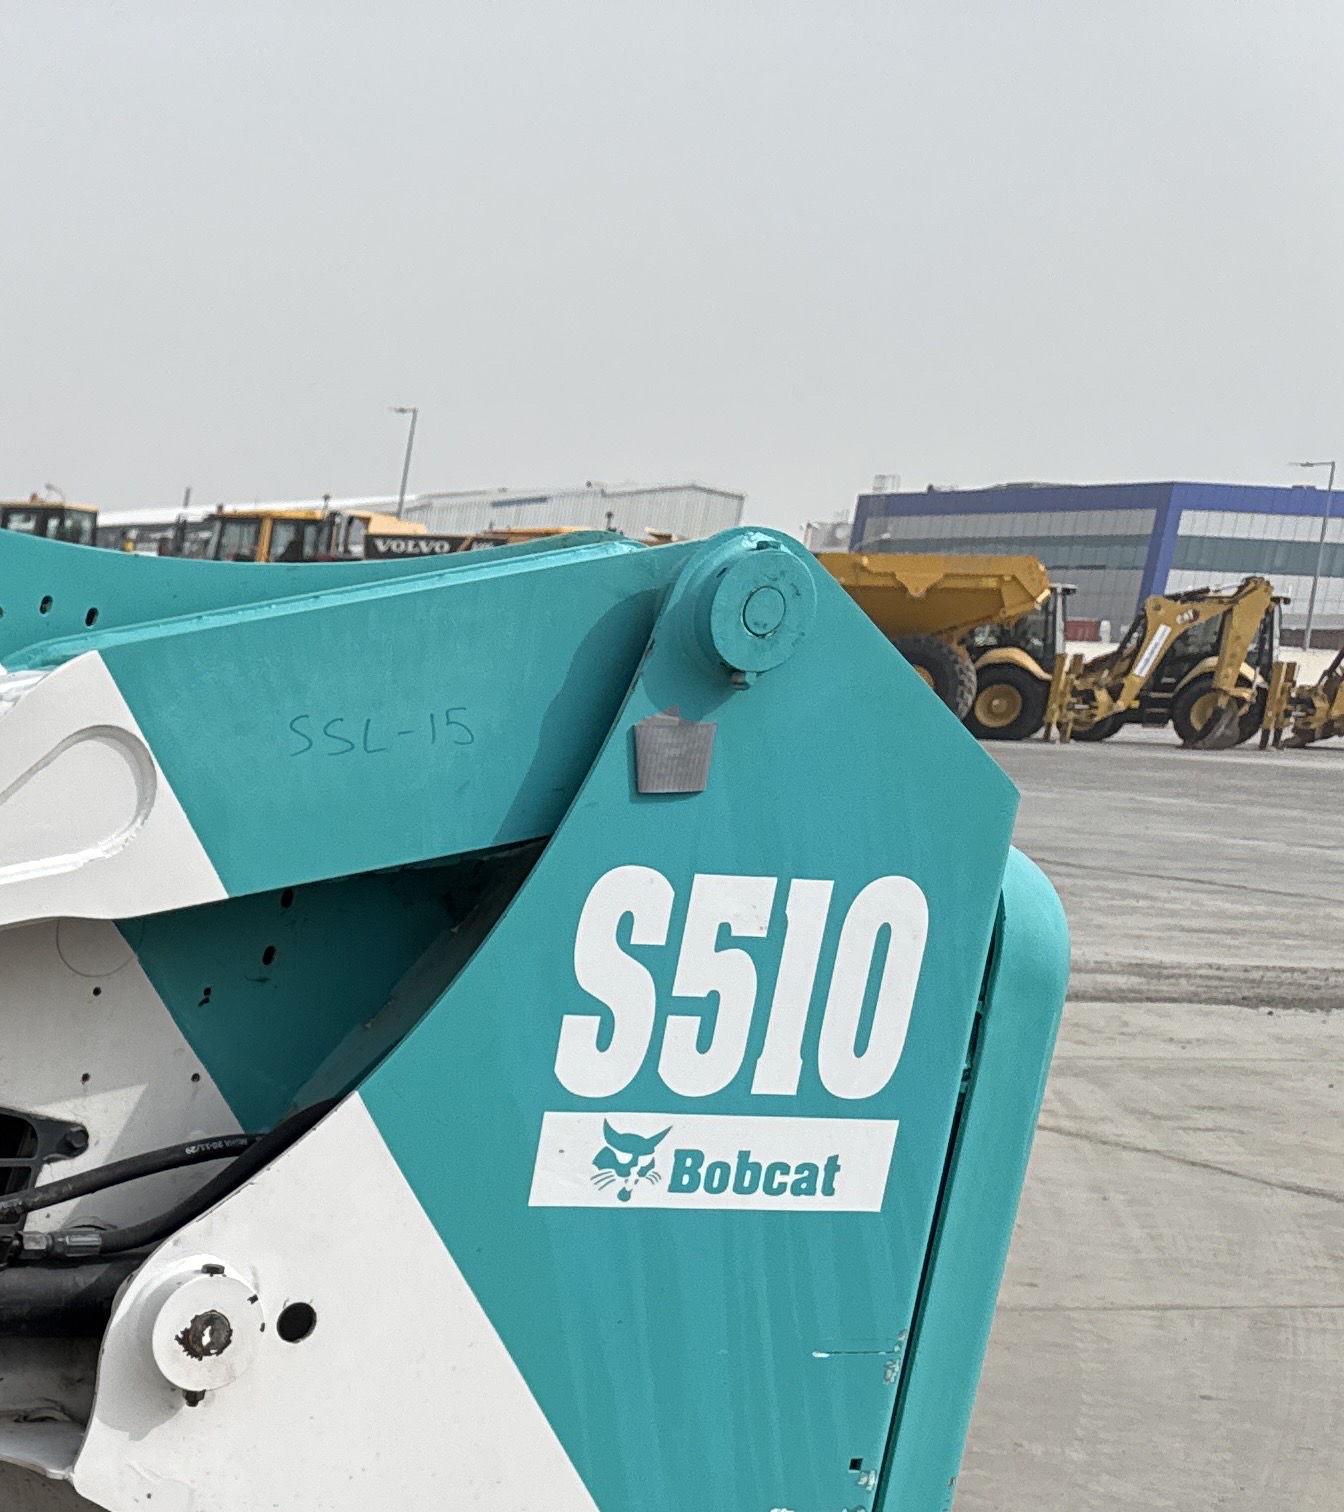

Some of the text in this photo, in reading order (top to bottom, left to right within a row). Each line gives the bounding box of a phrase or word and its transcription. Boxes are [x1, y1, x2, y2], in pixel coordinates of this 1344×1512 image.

[374, 538, 452, 554] VOLVO
[289, 706, 475, 757] SSL-15
[554, 865, 929, 1100] S510
[667, 1148, 842, 1197] Bobcat
